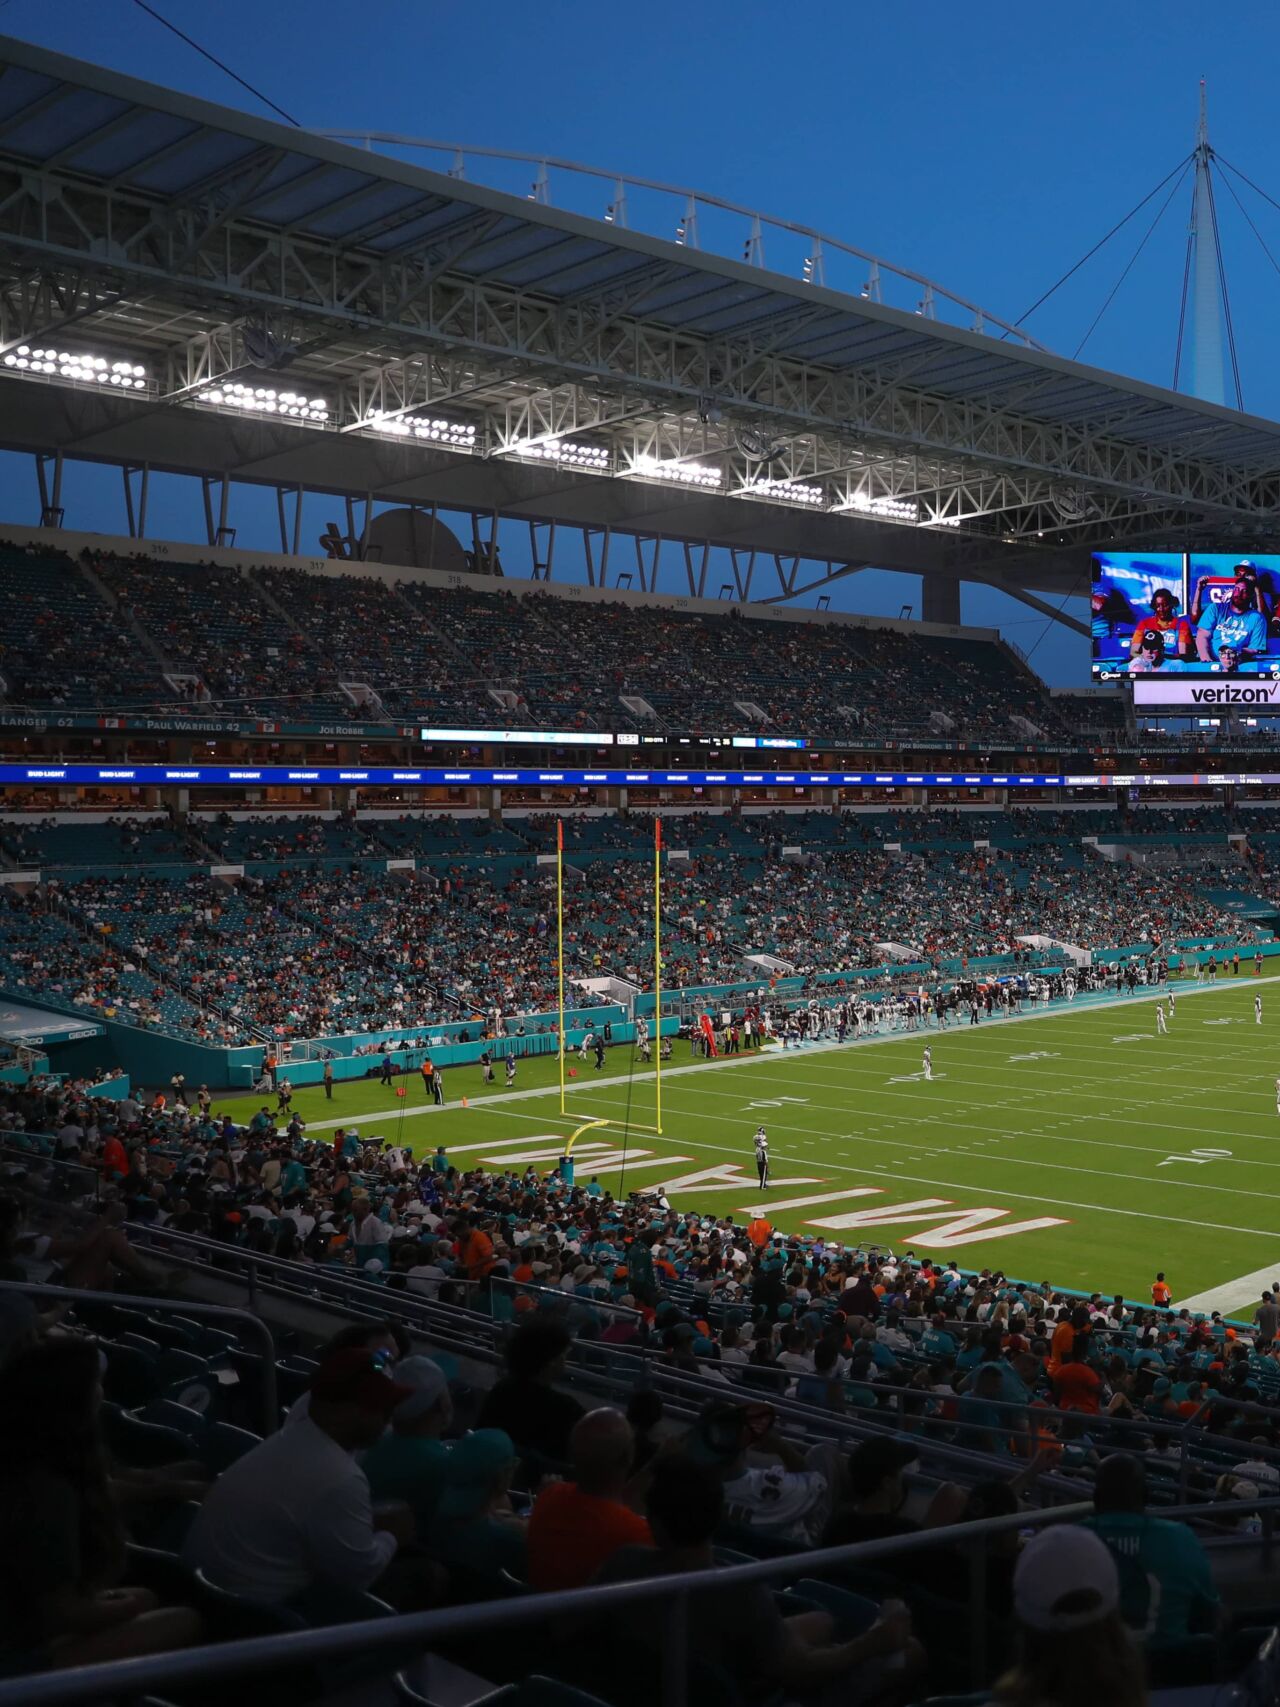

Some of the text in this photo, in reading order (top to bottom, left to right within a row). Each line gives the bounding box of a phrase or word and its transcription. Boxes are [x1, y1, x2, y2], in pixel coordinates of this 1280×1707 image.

[151, 545, 169, 554] 316
[309, 562, 326, 570] 317
[448, 576, 462, 584] 318
[1192, 685, 1270, 703] verizon
[57, 718, 74, 727] 62
[226, 723, 240, 732] 42
[69, 1030, 97, 1040] GEICO
[1166, 1148, 1232, 1164] 10
